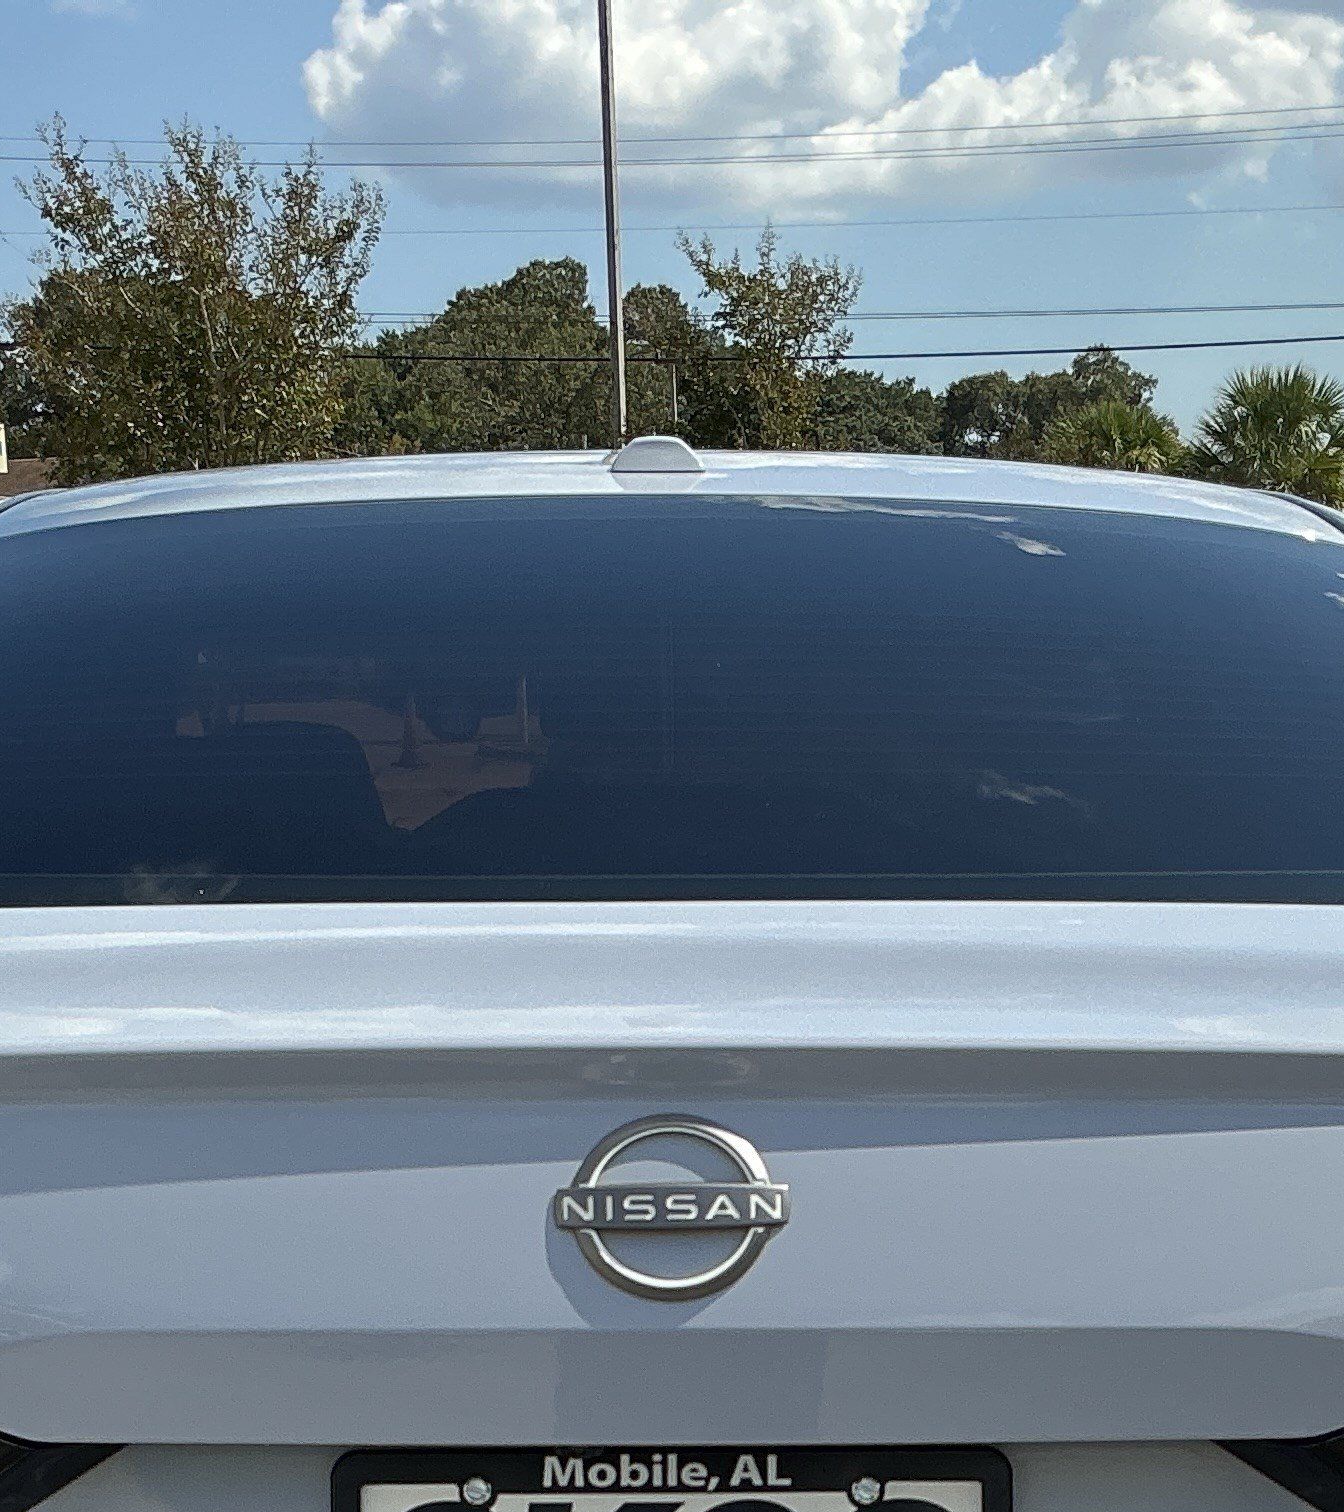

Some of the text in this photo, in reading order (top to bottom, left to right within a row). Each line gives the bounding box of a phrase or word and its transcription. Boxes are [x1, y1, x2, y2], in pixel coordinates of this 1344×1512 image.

[562, 1192, 783, 1222] NISSAN
[542, 1454, 793, 1492] Mobile, AL
